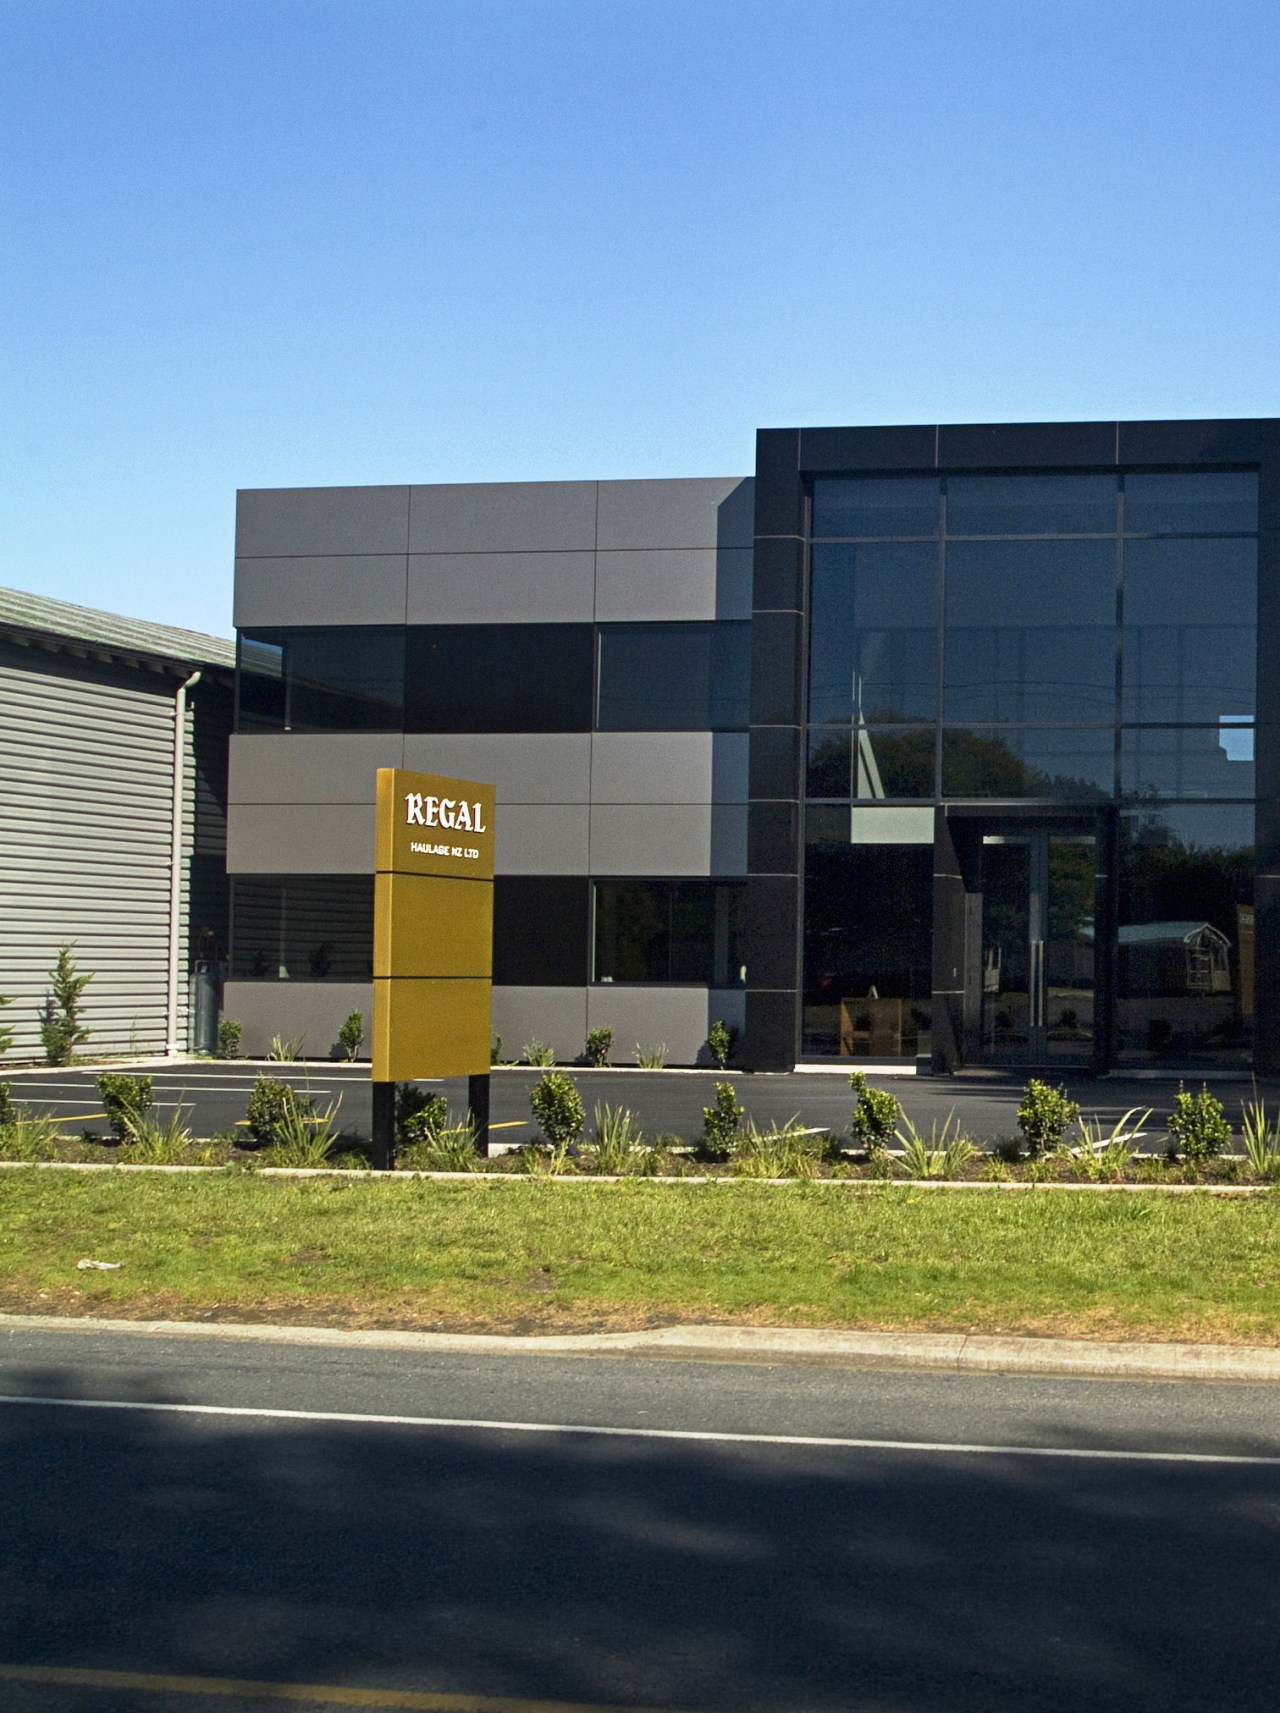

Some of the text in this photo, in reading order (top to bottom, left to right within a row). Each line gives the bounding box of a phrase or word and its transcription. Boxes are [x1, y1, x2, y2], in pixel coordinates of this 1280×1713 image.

[405, 793, 486, 833] REGAL
[411, 842, 479, 859] HAULAGE NZ LTD
